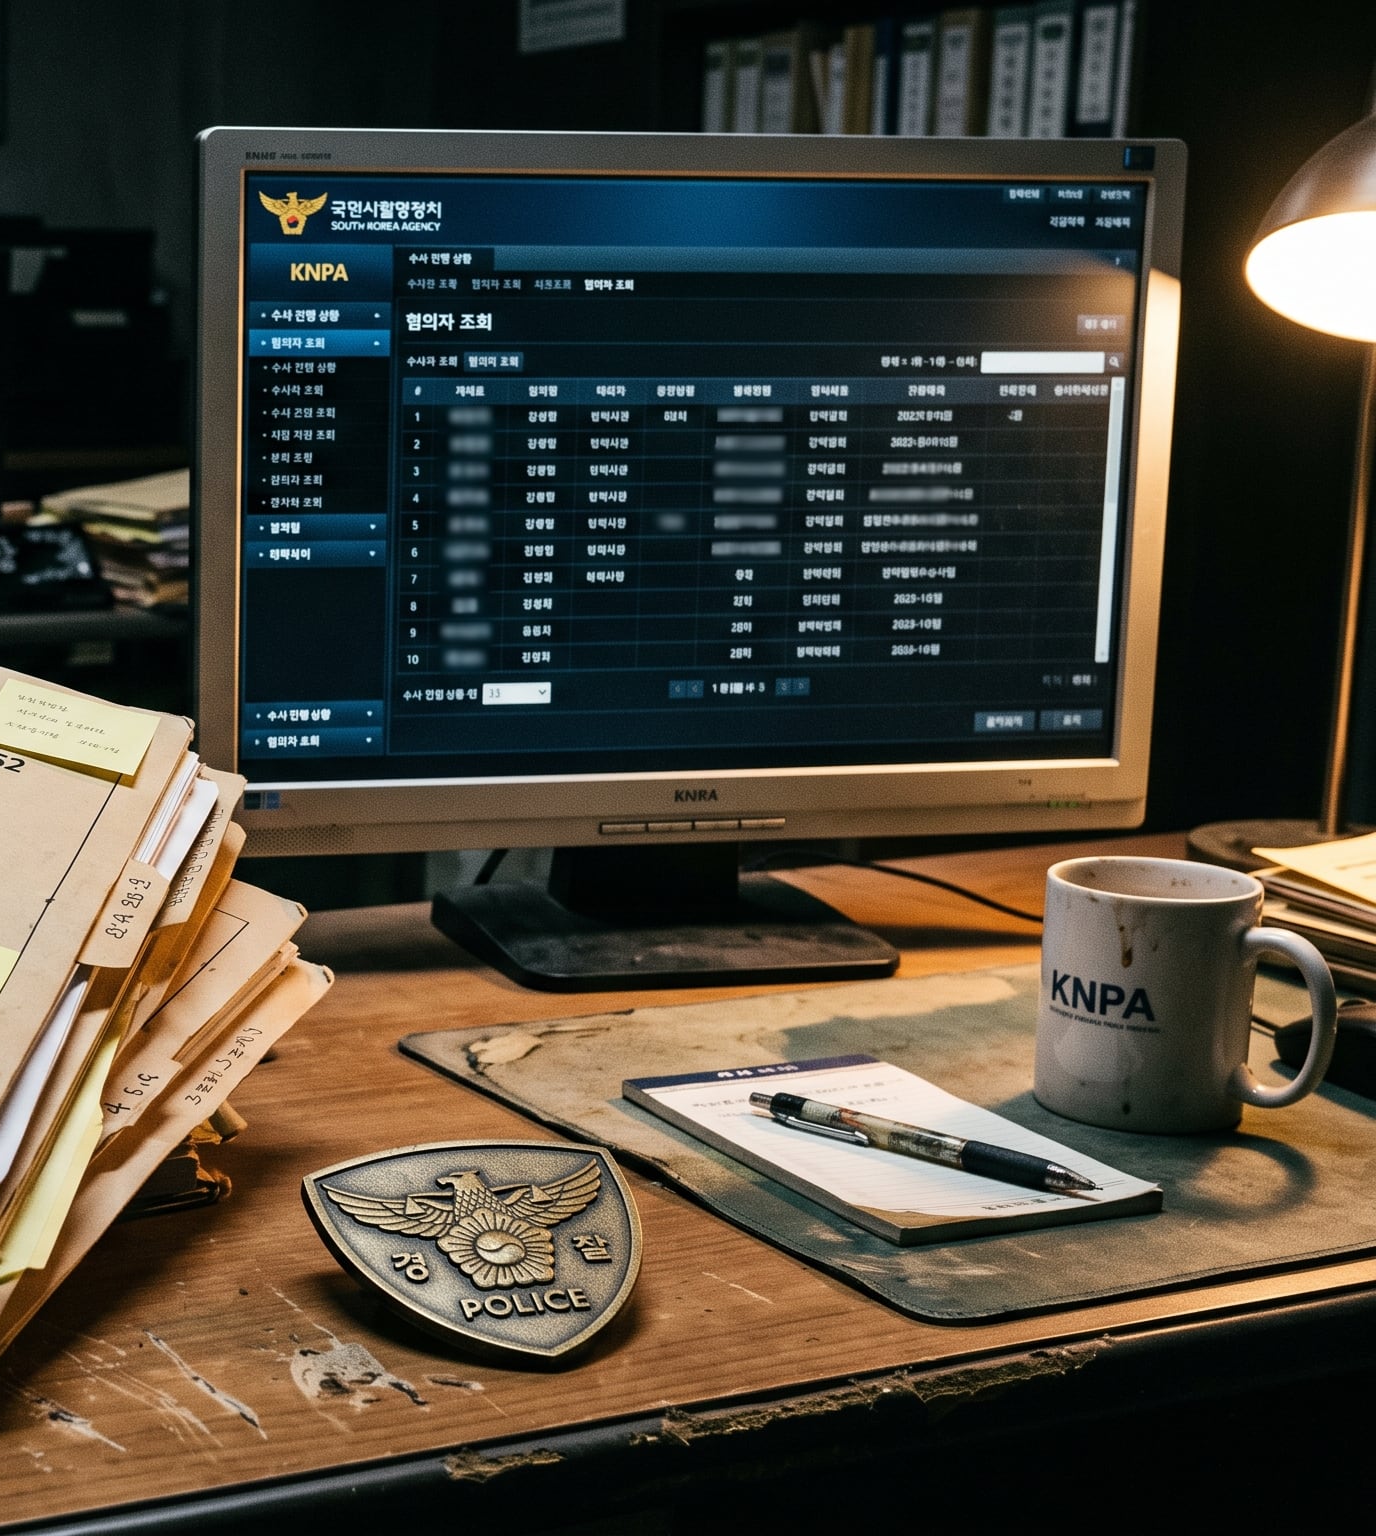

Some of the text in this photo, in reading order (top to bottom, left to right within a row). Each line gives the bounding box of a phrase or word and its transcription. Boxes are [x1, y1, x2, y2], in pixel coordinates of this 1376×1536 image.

[401, 221, 441, 231] AGENCY
[290, 263, 348, 281] KNPA
[406, 313, 492, 331] 혐의자 조회
[416, 413, 419, 421] 1
[414, 439, 420, 449] 2
[414, 467, 419, 476] 3
[413, 494, 419, 502] 4
[413, 520, 418, 530] 5
[411, 548, 418, 557] 6
[412, 574, 417, 583] 7
[411, 601, 416, 611] 8
[410, 628, 416, 637] 9
[408, 655, 419, 664] 10
[1051, 969, 1155, 1022] KNPA
[460, 1289, 591, 1320] POLICE
